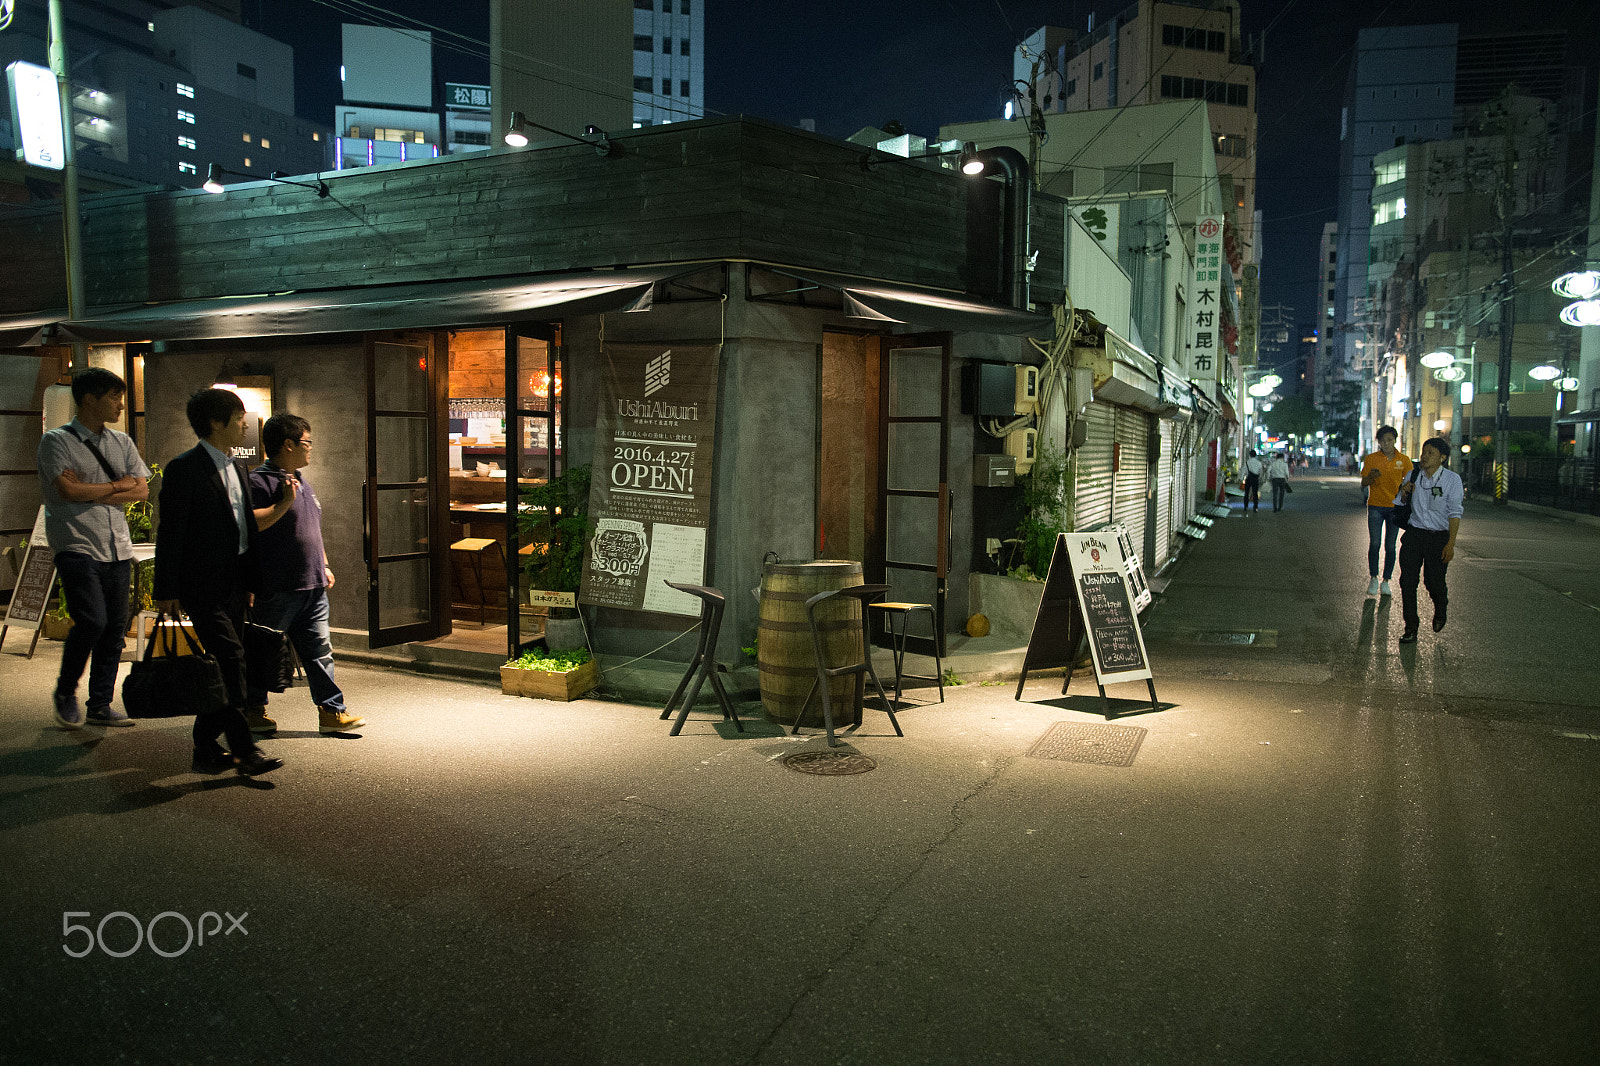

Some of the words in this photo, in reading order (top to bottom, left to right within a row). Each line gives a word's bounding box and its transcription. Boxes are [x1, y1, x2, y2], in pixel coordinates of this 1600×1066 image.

[454, 88, 491, 105] 松陽
[1194, 288, 1215, 371] 木村昆布
[614, 446, 689, 467] 2016.4.27
[611, 462, 694, 492] OPEN!
